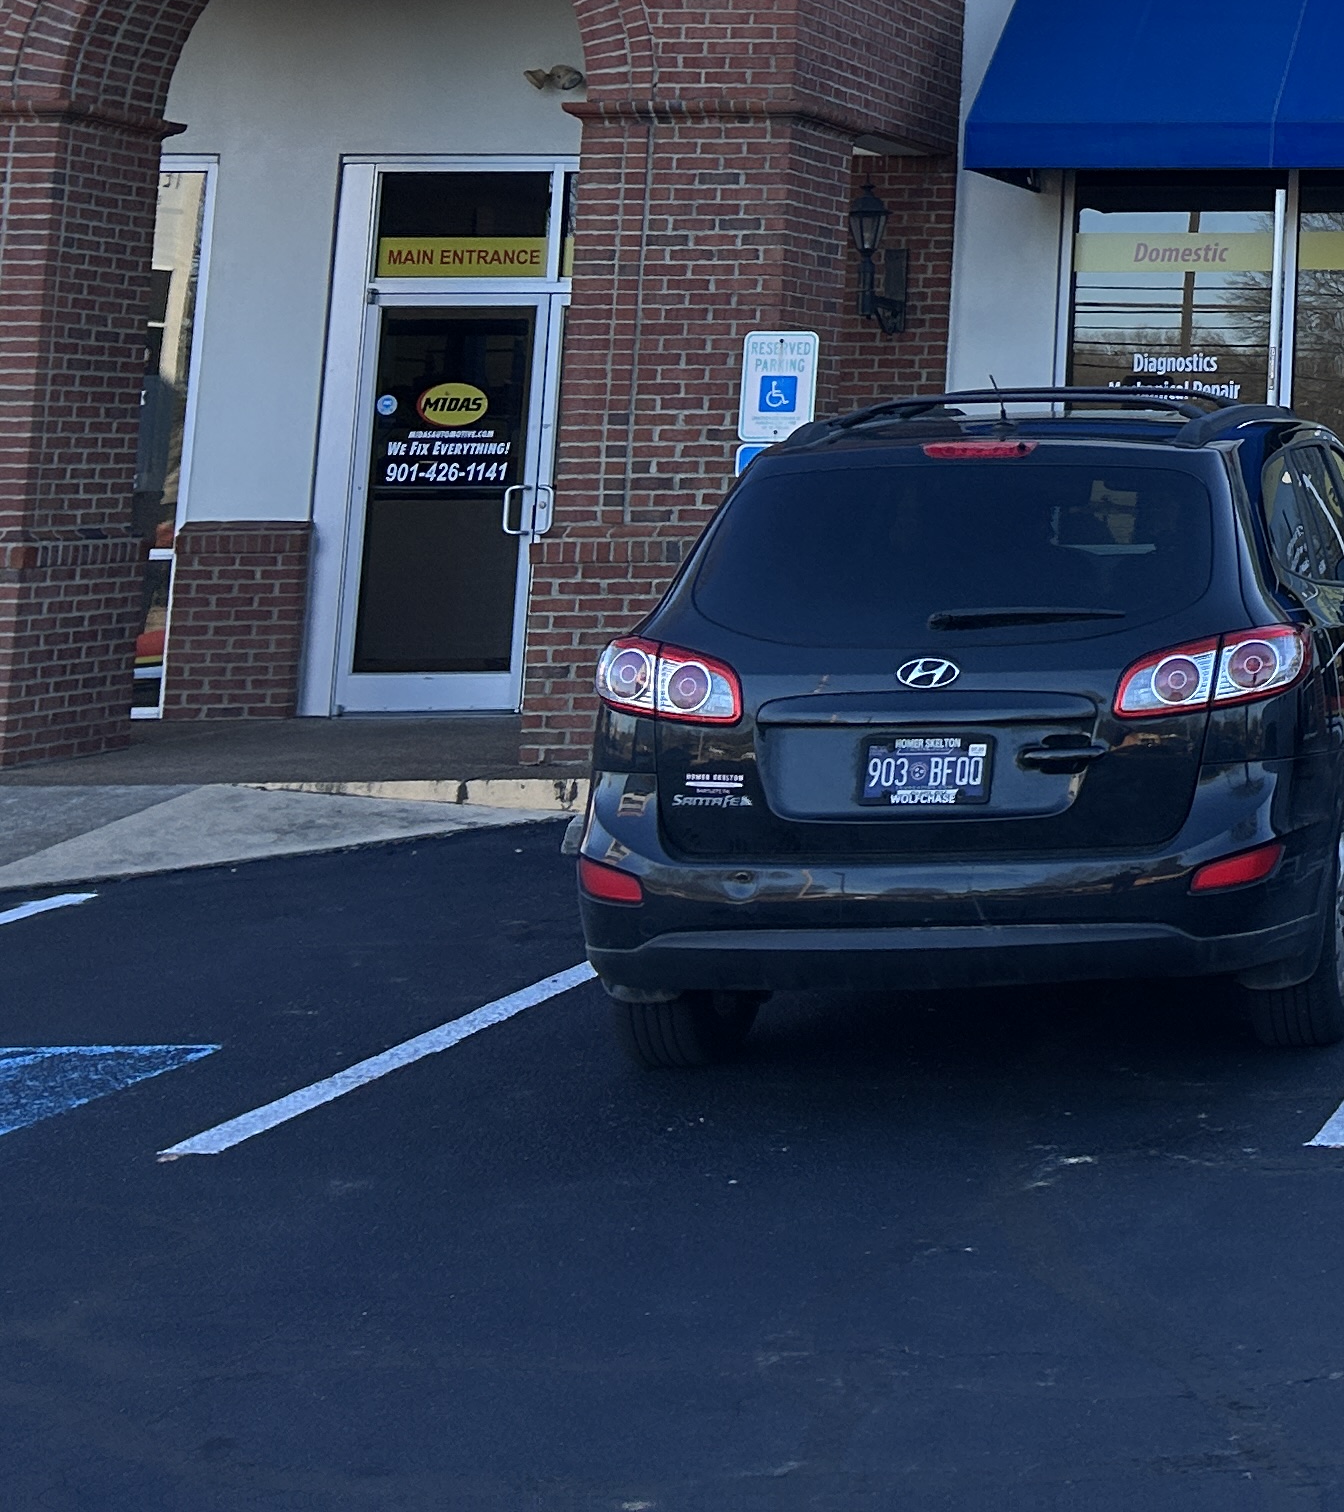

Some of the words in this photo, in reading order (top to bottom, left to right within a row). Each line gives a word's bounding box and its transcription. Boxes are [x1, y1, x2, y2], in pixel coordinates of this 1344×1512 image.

[387, 249, 434, 265] MAIN
[440, 249, 541, 265] ENTRANCE
[1133, 242, 1229, 263] Domestic
[751, 341, 811, 355] RESERVED
[754, 358, 806, 373] PARKING
[1132, 352, 1218, 375] Diagnostics
[423, 397, 485, 414] MIDAS
[385, 462, 509, 482] 901-426-1141
[895, 738, 924, 749] HOMER
[924, 737, 961, 749] SKELTON
[868, 757, 909, 788] 903
[890, 793, 956, 804] WOLFCHASE
